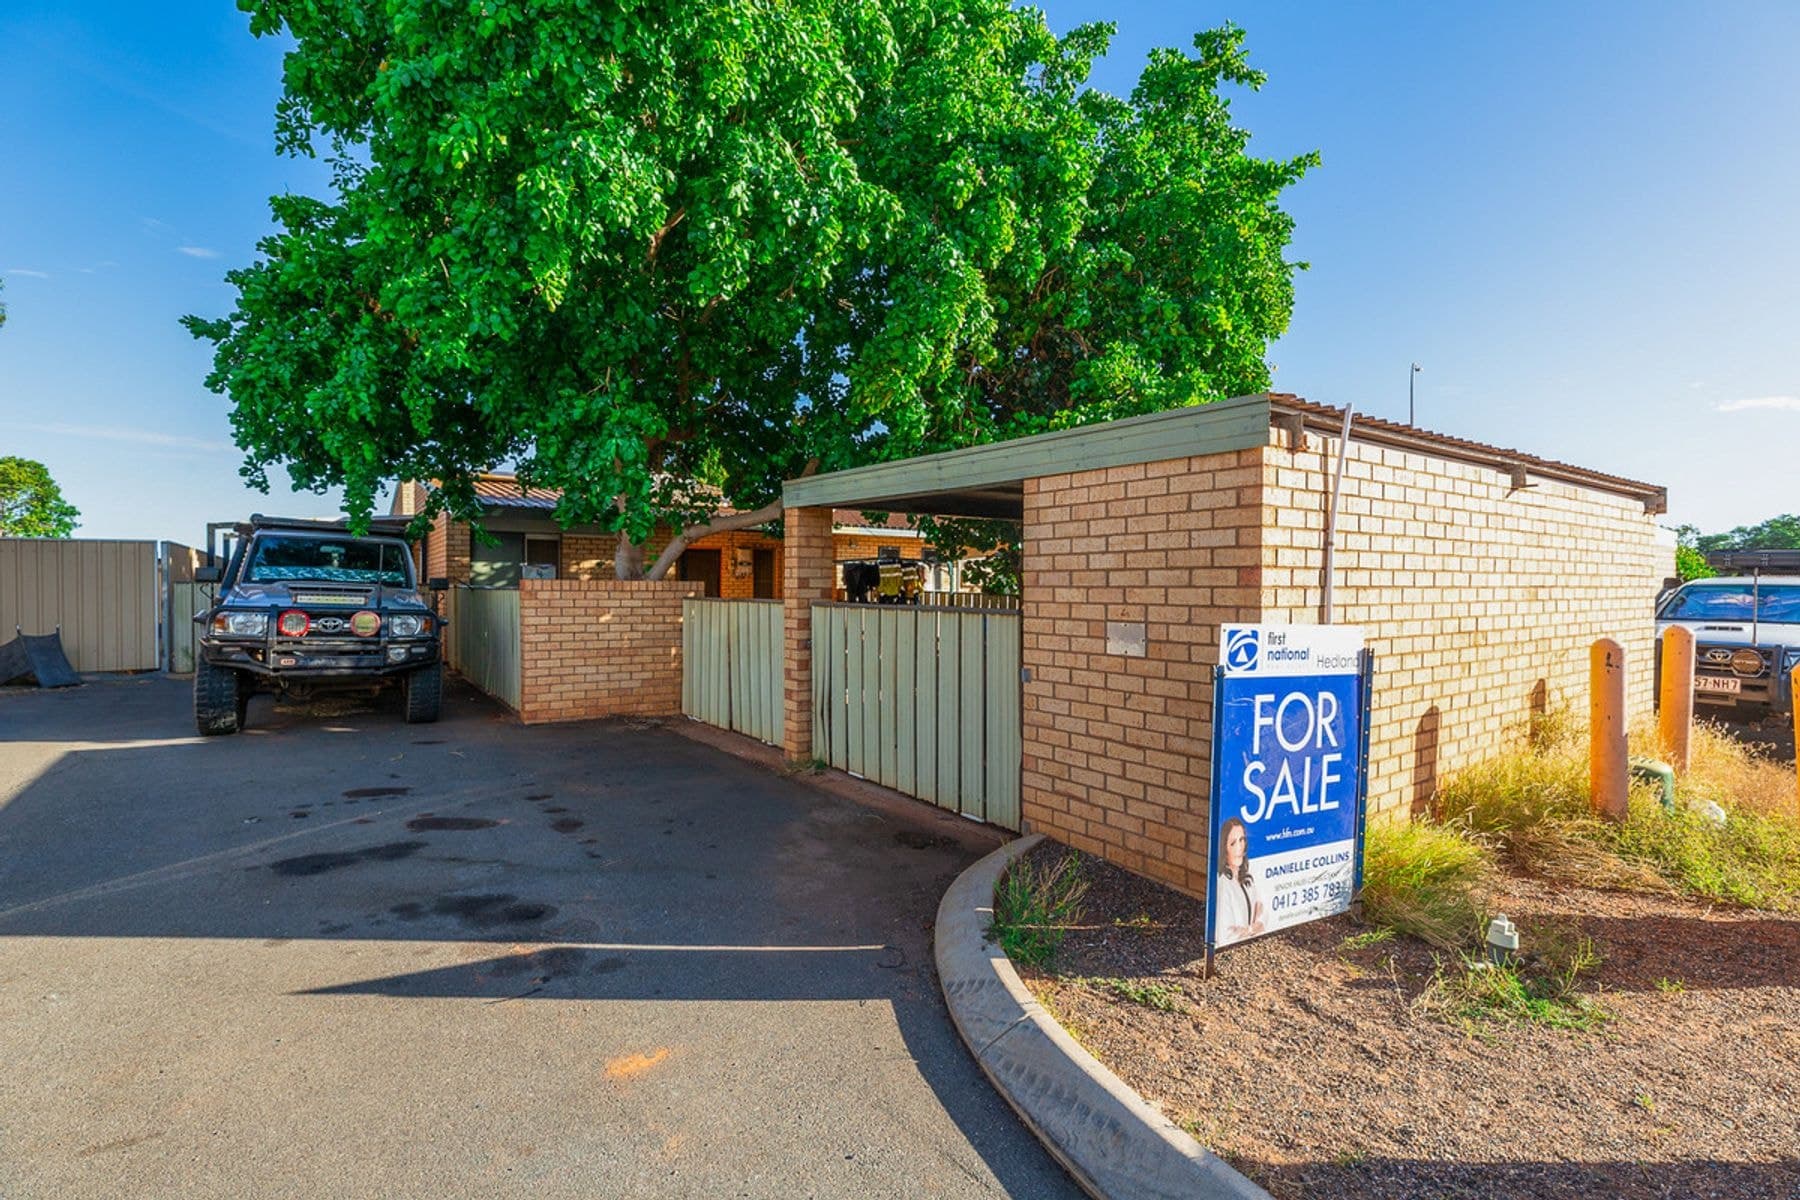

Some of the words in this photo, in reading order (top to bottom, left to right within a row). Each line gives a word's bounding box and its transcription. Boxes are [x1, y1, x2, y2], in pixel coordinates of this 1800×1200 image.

[1267, 632, 1286, 645] first
[1267, 647, 1310, 661] national
[1253, 691, 1338, 755] FOR
[1240, 752, 1342, 824] SALE
[1265, 859, 1310, 879] DANIELLE
[1312, 851, 1350, 868] COLLINS
[1272, 891, 1298, 911] 0412
[1301, 886, 1320, 904] 385
